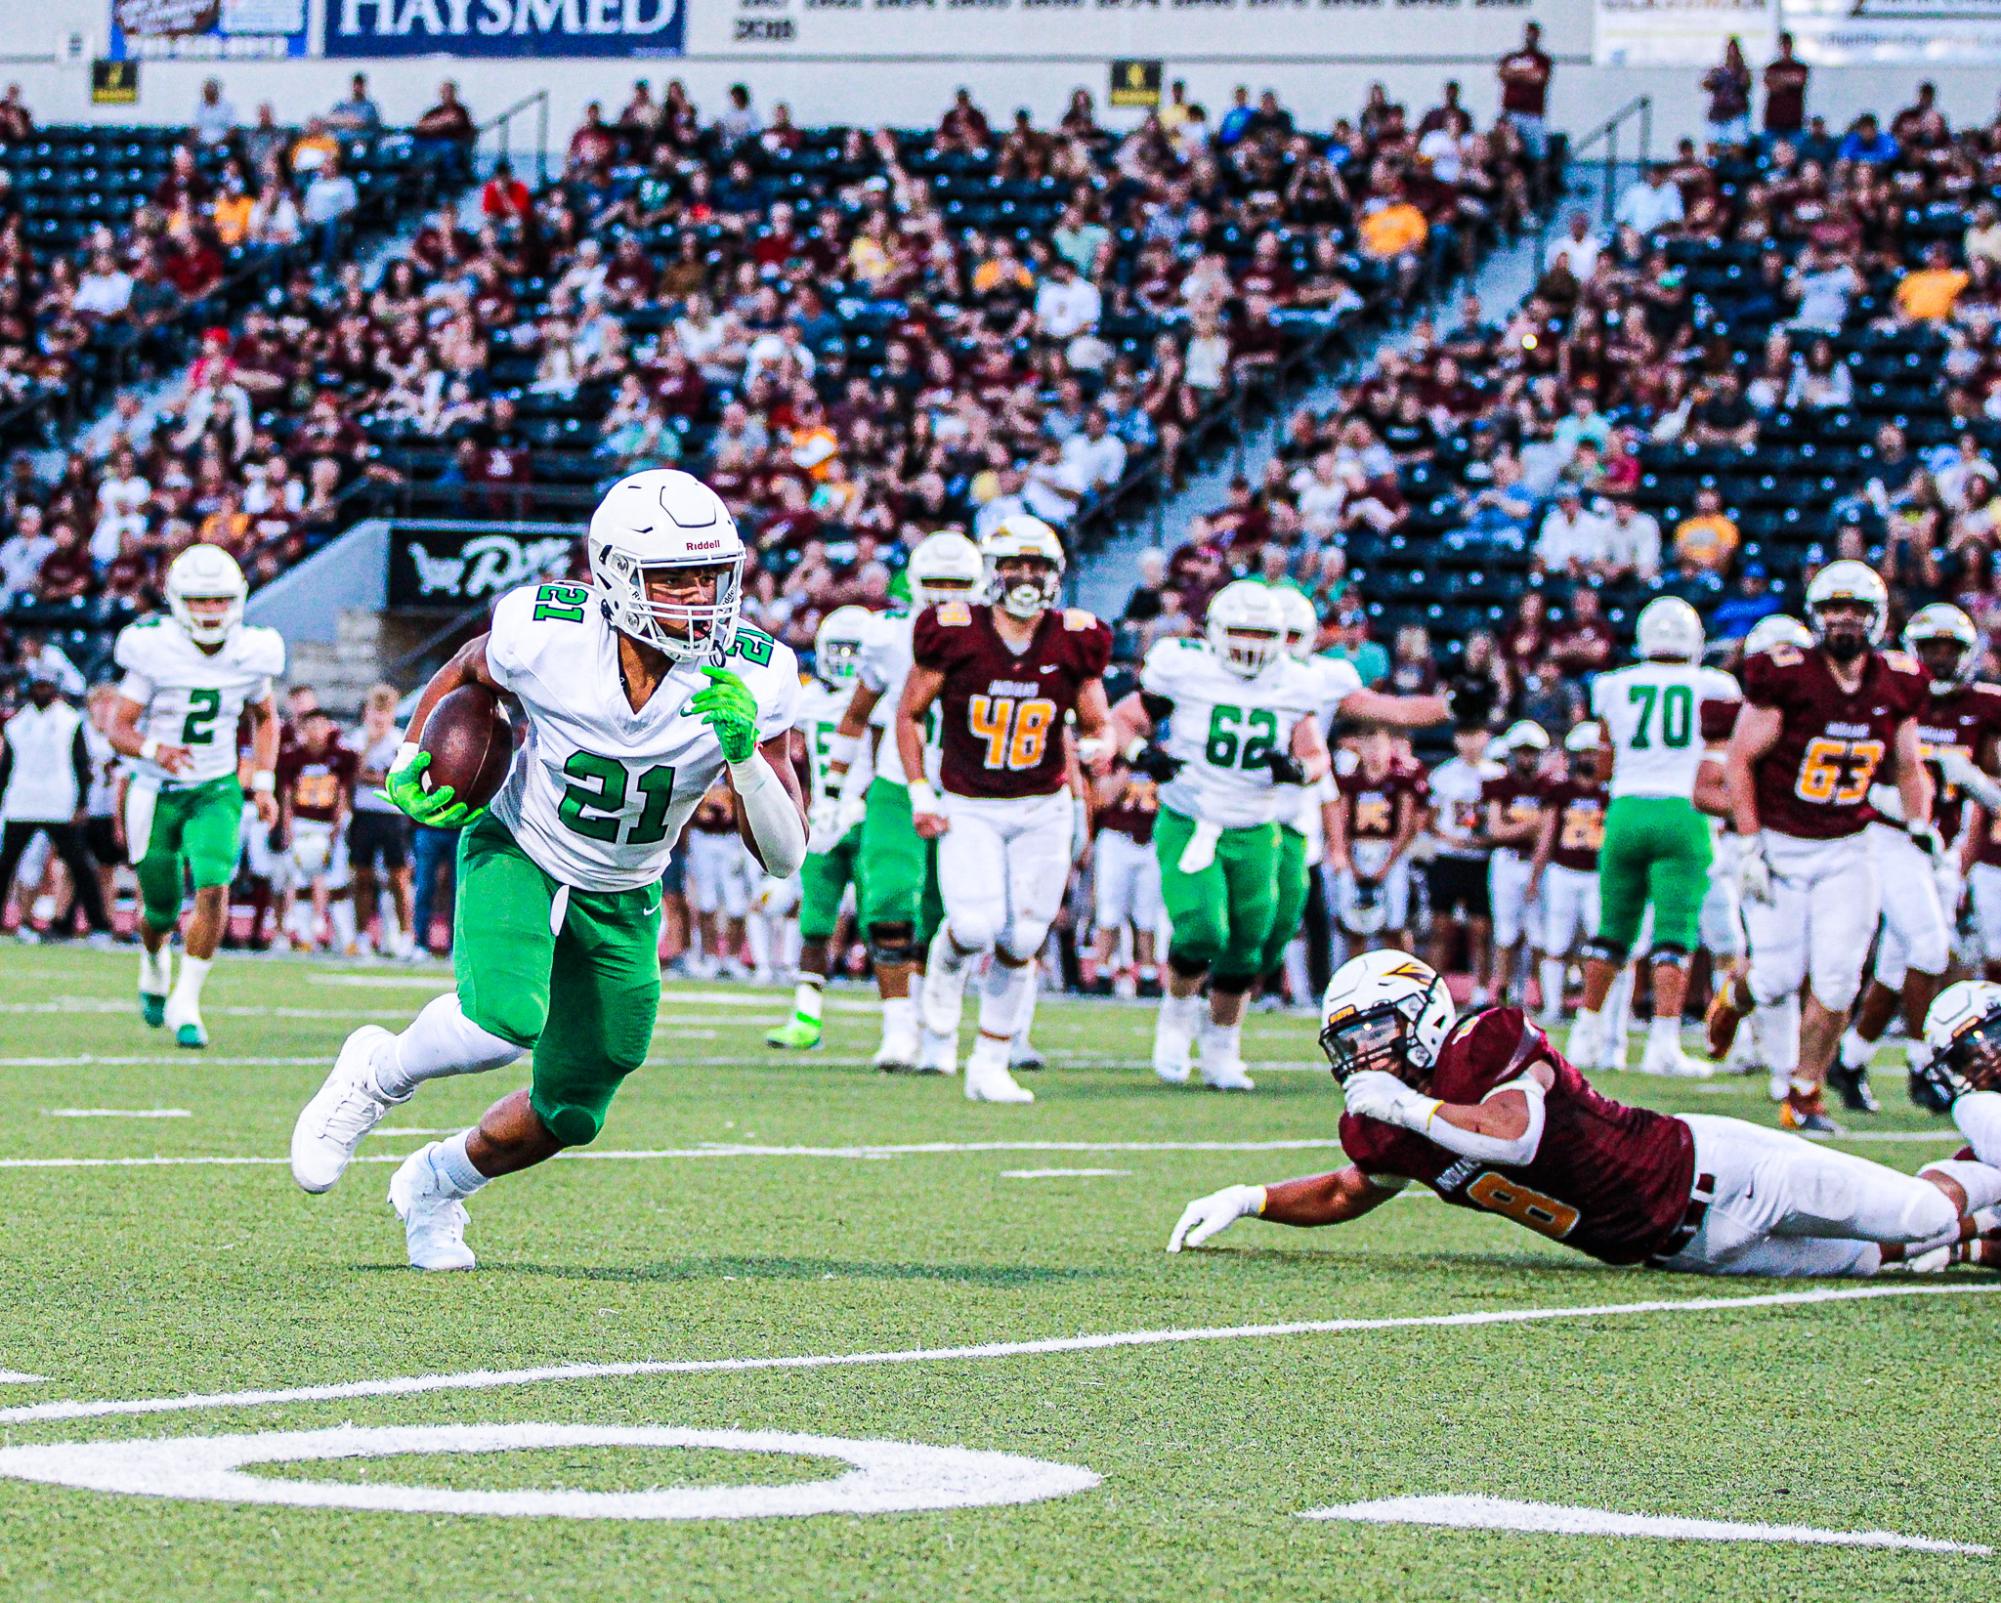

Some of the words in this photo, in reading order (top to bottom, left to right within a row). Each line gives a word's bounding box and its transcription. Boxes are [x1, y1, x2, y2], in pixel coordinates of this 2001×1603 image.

[686, 539, 721, 551] Riddell
[532, 584, 589, 624] 21
[181, 688, 222, 745] 2
[969, 694, 1058, 771] 48
[1206, 704, 1277, 771] 62
[1629, 684, 1693, 749] 70
[558, 749, 676, 845] 21
[1795, 736, 1886, 805] 63
[1466, 1171, 1581, 1238] 8
